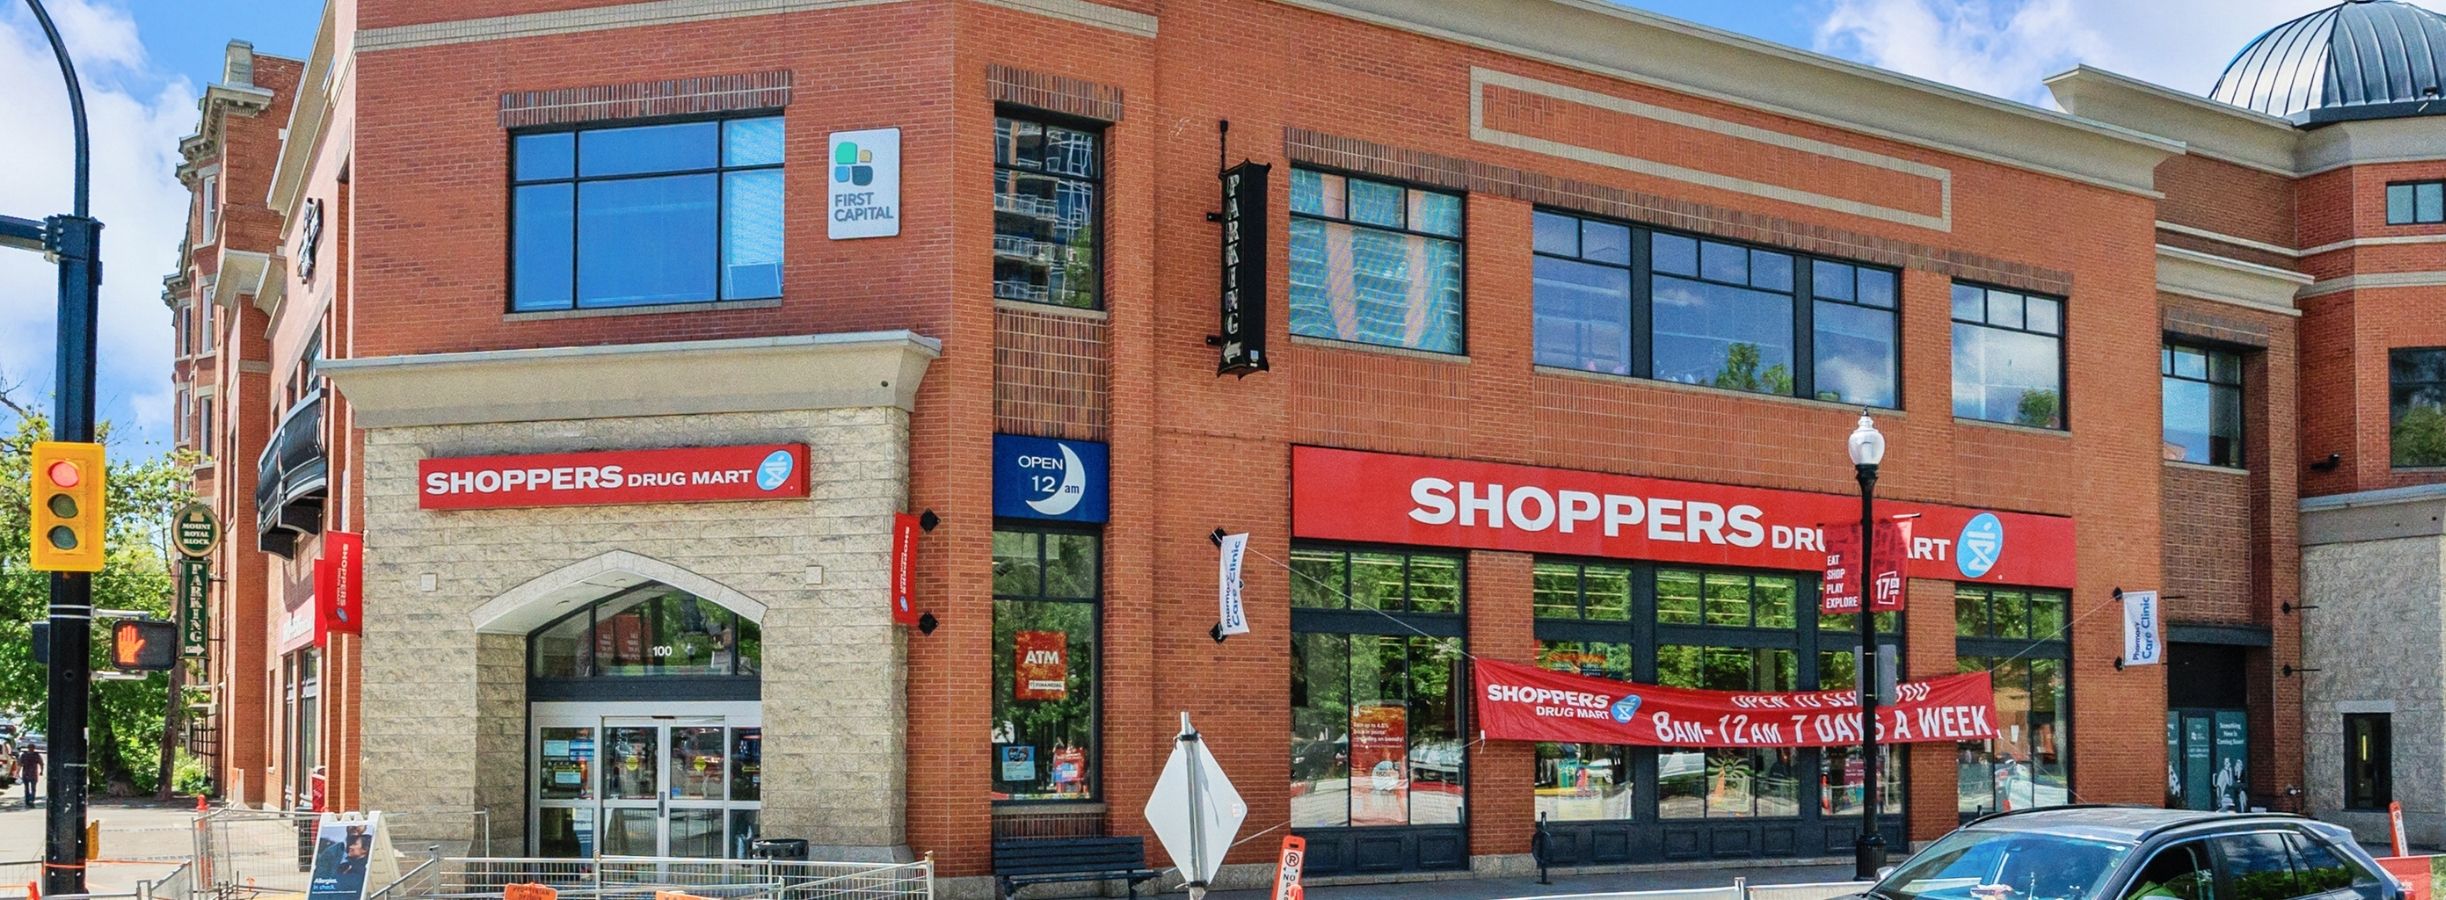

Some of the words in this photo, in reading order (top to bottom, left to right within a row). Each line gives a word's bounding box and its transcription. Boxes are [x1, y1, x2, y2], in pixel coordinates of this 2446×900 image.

[834, 192, 874, 207] FIRST
[834, 206, 894, 222] CAPITAL
[1225, 174, 1240, 334] PARKING
[1018, 455, 1063, 470] OPEN
[426, 465, 624, 495] SHOPPERS
[628, 472, 686, 487] DRUG
[692, 469, 752, 485] MART
[1031, 475, 1055, 493] 12
[1064, 485, 1080, 494] am
[1407, 477, 1765, 548] SHOPPERS
[1906, 536, 1951, 561] RT
[183, 537, 210, 545] BLOCK
[1229, 541, 1241, 583] Clinic
[1826, 554, 1841, 566] EAT
[340, 543, 349, 606] SHOPPERS
[1826, 568, 1846, 580] SHOP
[1826, 583, 1845, 594] PLAY
[1876, 577, 1890, 600] 17
[190, 564, 203, 643] PARKING
[1232, 589, 1240, 626] Care
[1826, 596, 1858, 608] EXPLORE
[2140, 597, 2150, 629] Clinic
[652, 645, 673, 657] 100
[2142, 632, 2153, 659] Care
[1025, 650, 1059, 665] ATM
[1487, 684, 1611, 709] SHOPPERS
[1731, 695, 1790, 709] OPEN
[1793, 694, 1822, 708] TO
[1536, 706, 1574, 718] DRUG
[1577, 708, 1609, 720] MART
[1791, 715, 1807, 743] 7
[1894, 710, 1912, 739] A
[1917, 705, 1992, 738] WEEK
[1283, 874, 1296, 882] NO
